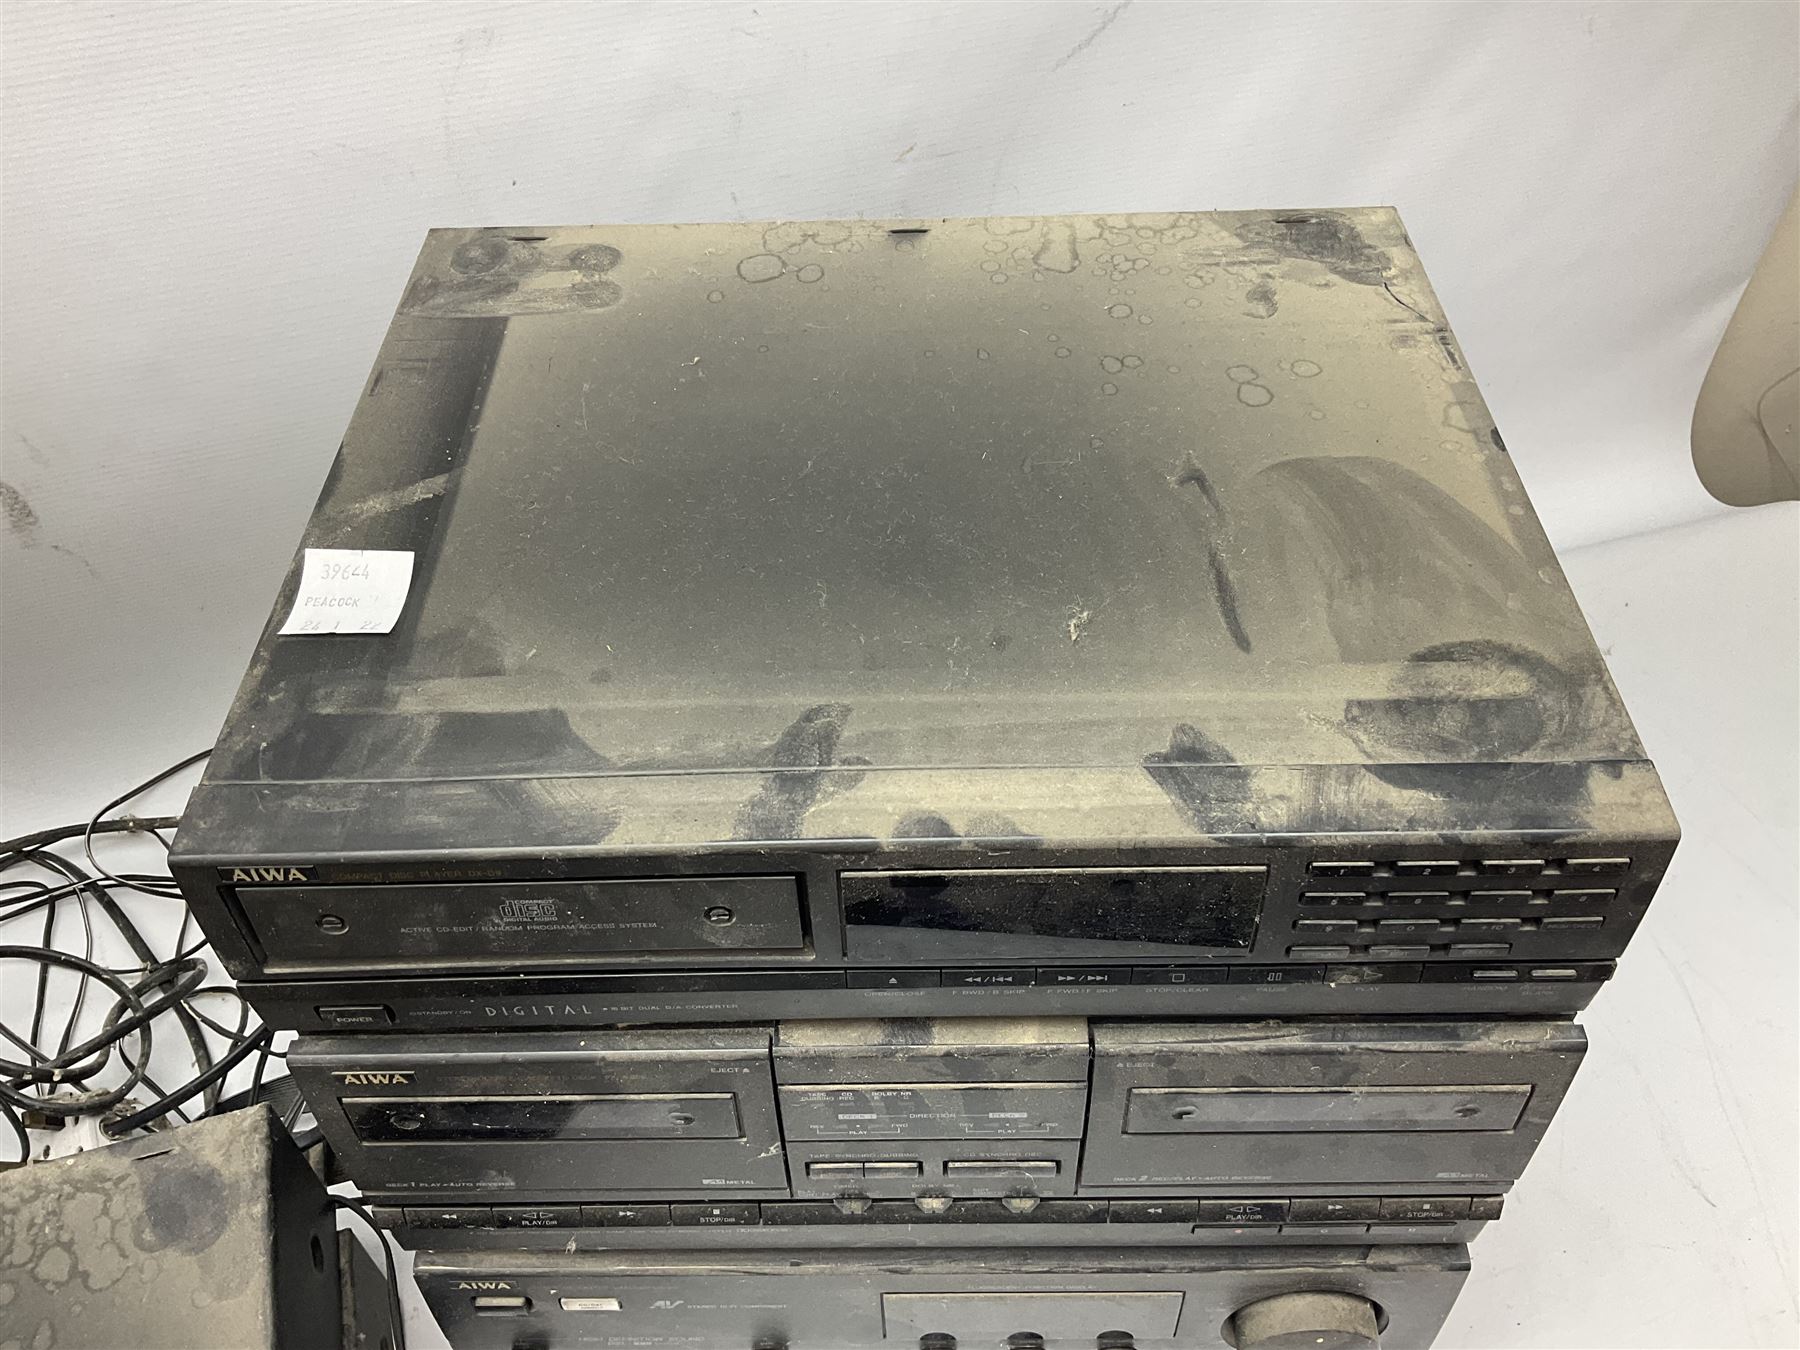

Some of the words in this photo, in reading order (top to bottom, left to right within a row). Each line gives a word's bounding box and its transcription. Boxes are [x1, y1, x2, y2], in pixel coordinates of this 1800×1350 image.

[320, 563, 370, 581] 39644
[304, 596, 360, 608] PEACOCK
[232, 867, 308, 882] AIWA
[1423, 867, 1431, 876] 2
[1507, 866, 1516, 875] 3
[500, 900, 557, 918] disc
[400, 926, 432, 934] ACTIVE
[527, 924, 576, 932] PROGRAM
[484, 1004, 593, 1017] DIGITAL
[344, 1074, 409, 1085] AIWA
[458, 1281, 511, 1290] AIWA
